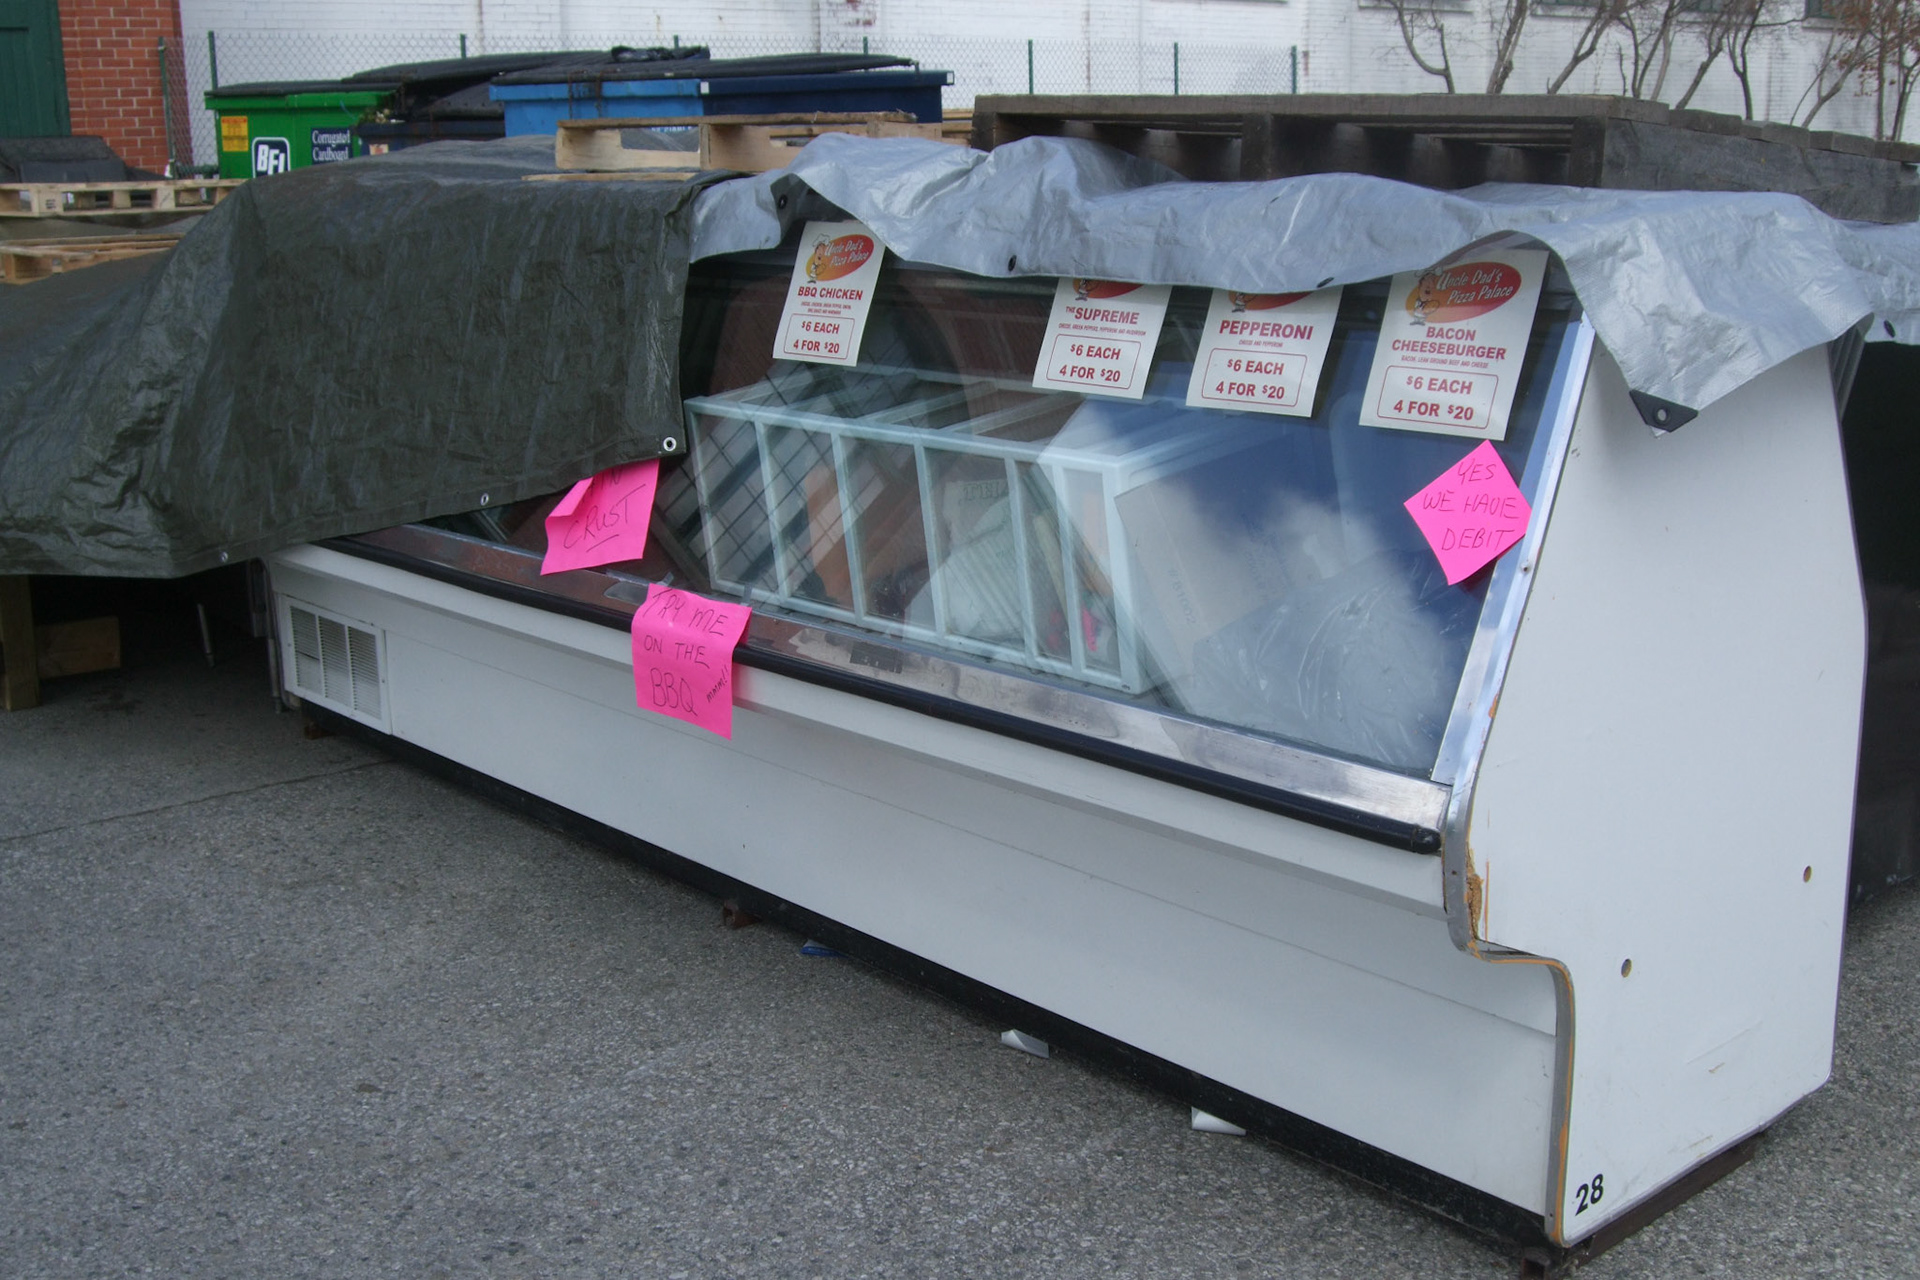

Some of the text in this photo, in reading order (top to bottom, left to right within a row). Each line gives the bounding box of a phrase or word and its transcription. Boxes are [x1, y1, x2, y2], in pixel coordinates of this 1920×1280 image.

[256, 144, 286, 175] BFI
[1436, 268, 1502, 290] Uncle Dad's
[798, 286, 863, 301] BBQ CHICKEN
[1447, 284, 1513, 305] Pizza Palace
[1074, 307, 1140, 325] SUPREME
[801, 321, 840, 334] $6 EACH
[1219, 319, 1314, 340] PEPPERONI
[1426, 326, 1476, 341] BACON
[793, 339, 840, 354] 4 FOR $20
[1070, 344, 1121, 360] $6 EACH
[1392, 339, 1506, 360] CHEESEBURGER
[1059, 365, 1121, 382] 4 FOR $20
[1227, 358, 1284, 375] $6 EACH
[1215, 381, 1285, 399] 4 FOR $20
[1406, 375, 1473, 395] $6 EACH
[1393, 399, 1474, 421] 4 FOR $20
[1457, 458, 1497, 485] YES
[1423, 490, 1520, 519] WE HAVE
[563, 483, 646, 549] CRUST
[1441, 527, 1516, 551] DEBIT
[643, 588, 728, 636] TRY ME
[643, 635, 710, 669] ON THE
[650, 667, 698, 716] BBQ
[1575, 1173, 1604, 1216] 28
